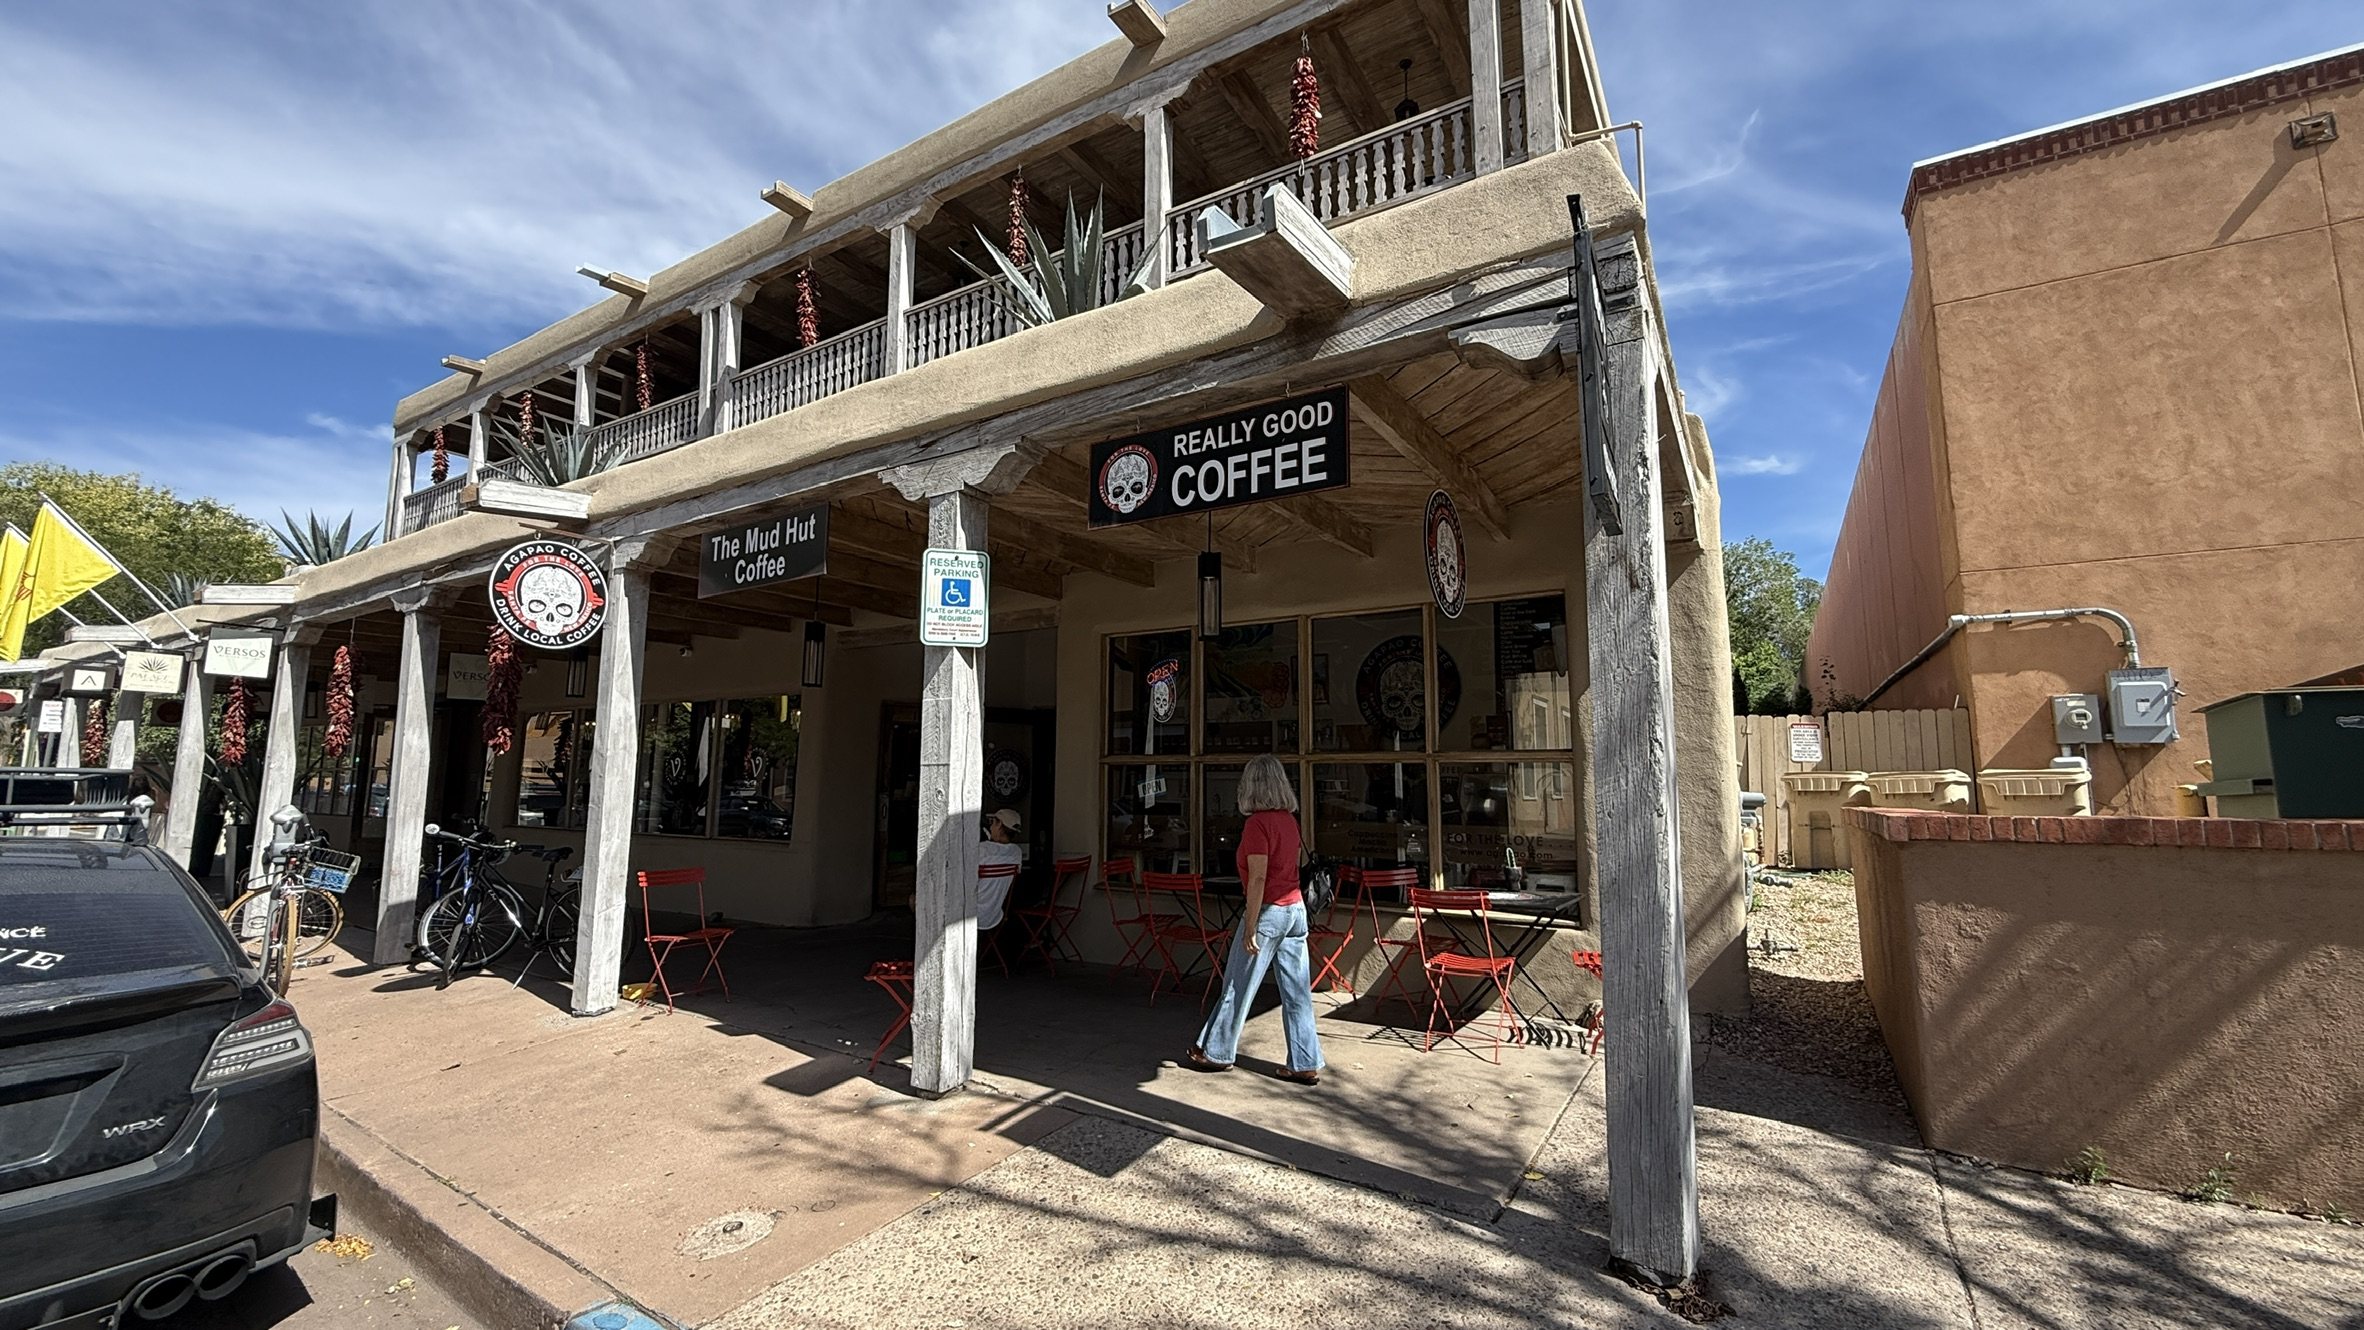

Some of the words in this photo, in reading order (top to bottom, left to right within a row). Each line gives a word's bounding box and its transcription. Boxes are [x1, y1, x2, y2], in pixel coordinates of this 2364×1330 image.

[1174, 418, 1256, 458] REALLY
[1263, 401, 1333, 438] GOOD
[1171, 437, 1328, 507] COFFEE
[711, 535, 740, 562] The
[745, 521, 780, 554] Mud
[785, 513, 816, 545] Hut
[503, 545, 554, 572] AGAPAO
[560, 548, 600, 586] COFFEE
[523, 556, 540, 568] FOR
[735, 553, 786, 584] Coffee
[930, 557, 984, 569] RESERVED
[933, 568, 979, 578] PARKING
[496, 598, 523, 632] DRINK
[523, 629, 563, 645] LOCAL
[566, 612, 600, 642] COFFEE
[955, 608, 983, 616] PLACARD
[213, 645, 266, 659] VERSOS
[1146, 660, 1179, 685] OPEN
[1142, 779, 1162, 796] OPEN
[1447, 832, 1472, 845] FOR
[1478, 833, 1502, 845] THE
[103, 1116, 166, 1139] WRX
